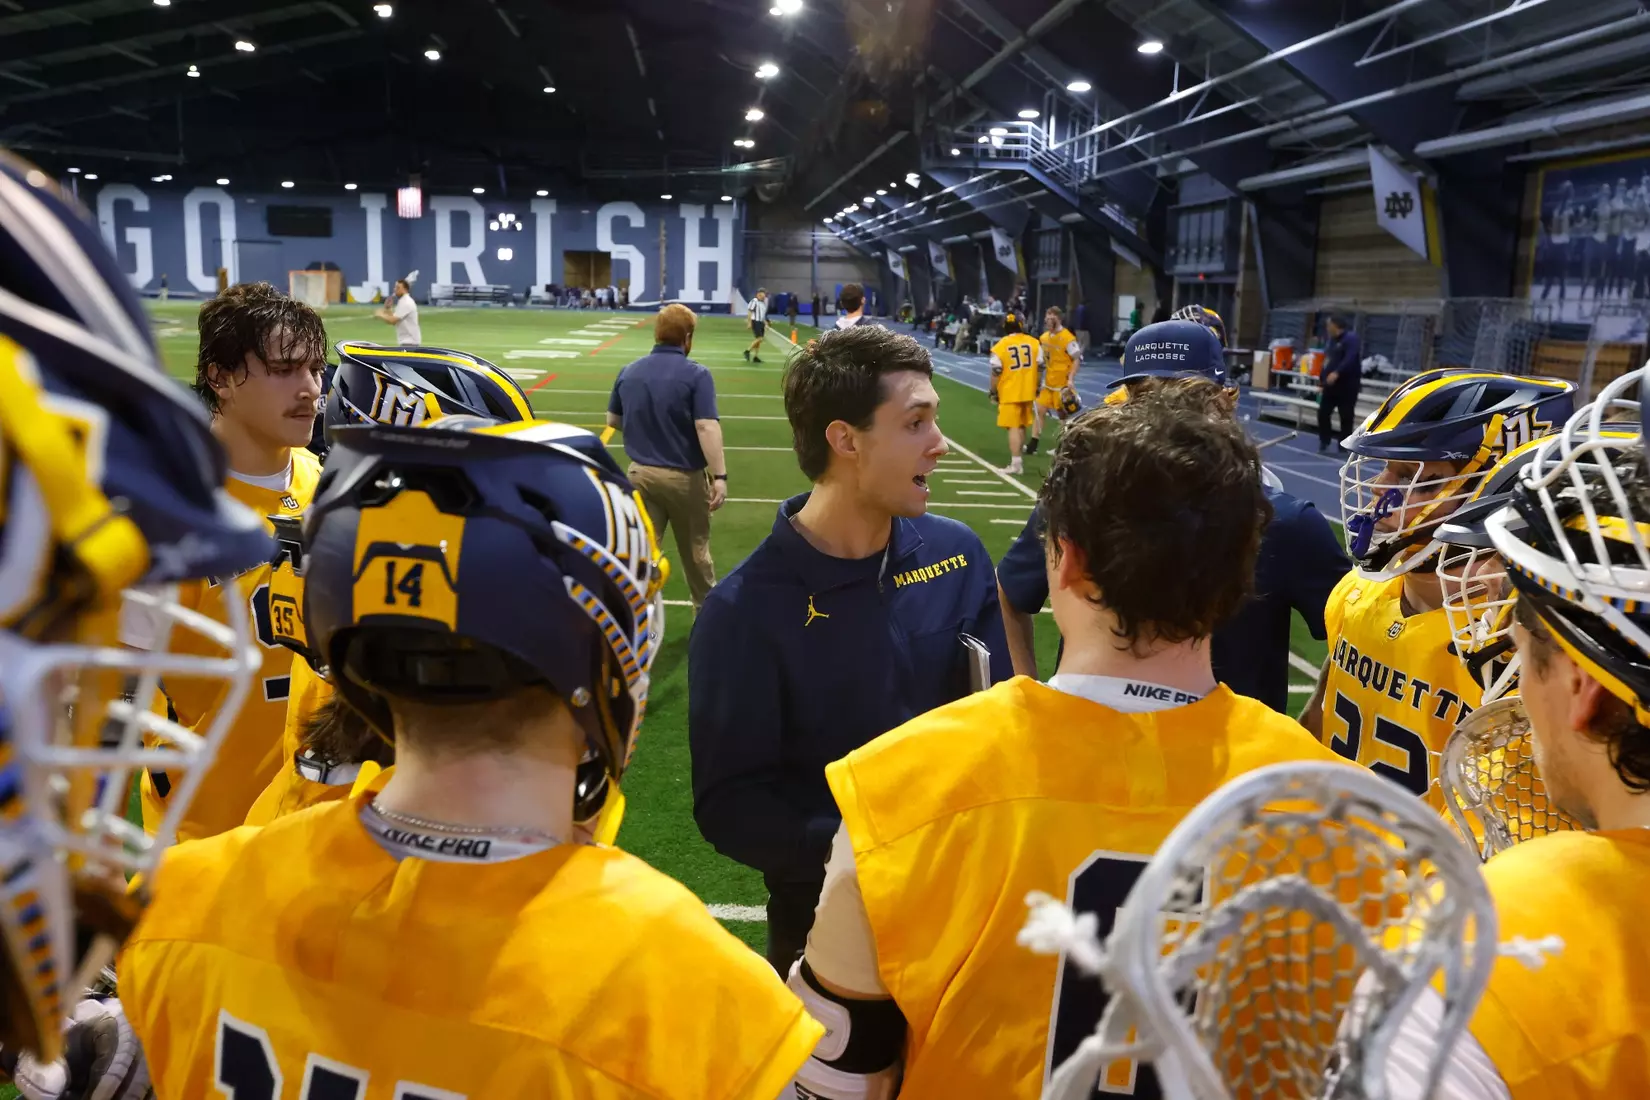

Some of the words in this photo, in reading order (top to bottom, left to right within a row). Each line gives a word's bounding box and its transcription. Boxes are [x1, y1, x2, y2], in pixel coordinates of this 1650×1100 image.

[97, 183, 240, 292] GO
[360, 192, 738, 304] IRISH
[1008, 344, 1031, 370] 33
[1134, 342, 1190, 353] MARQUETTE
[1135, 352, 1186, 362] LACROSSE
[383, 560, 424, 607] 14
[893, 554, 968, 588] MARQUETTE
[273, 606, 294, 637] 35
[1123, 683, 1172, 702] NIKE
[1174, 692, 1199, 705] PR
[382, 829, 436, 850] NIKE
[438, 837, 491, 857] PRO
